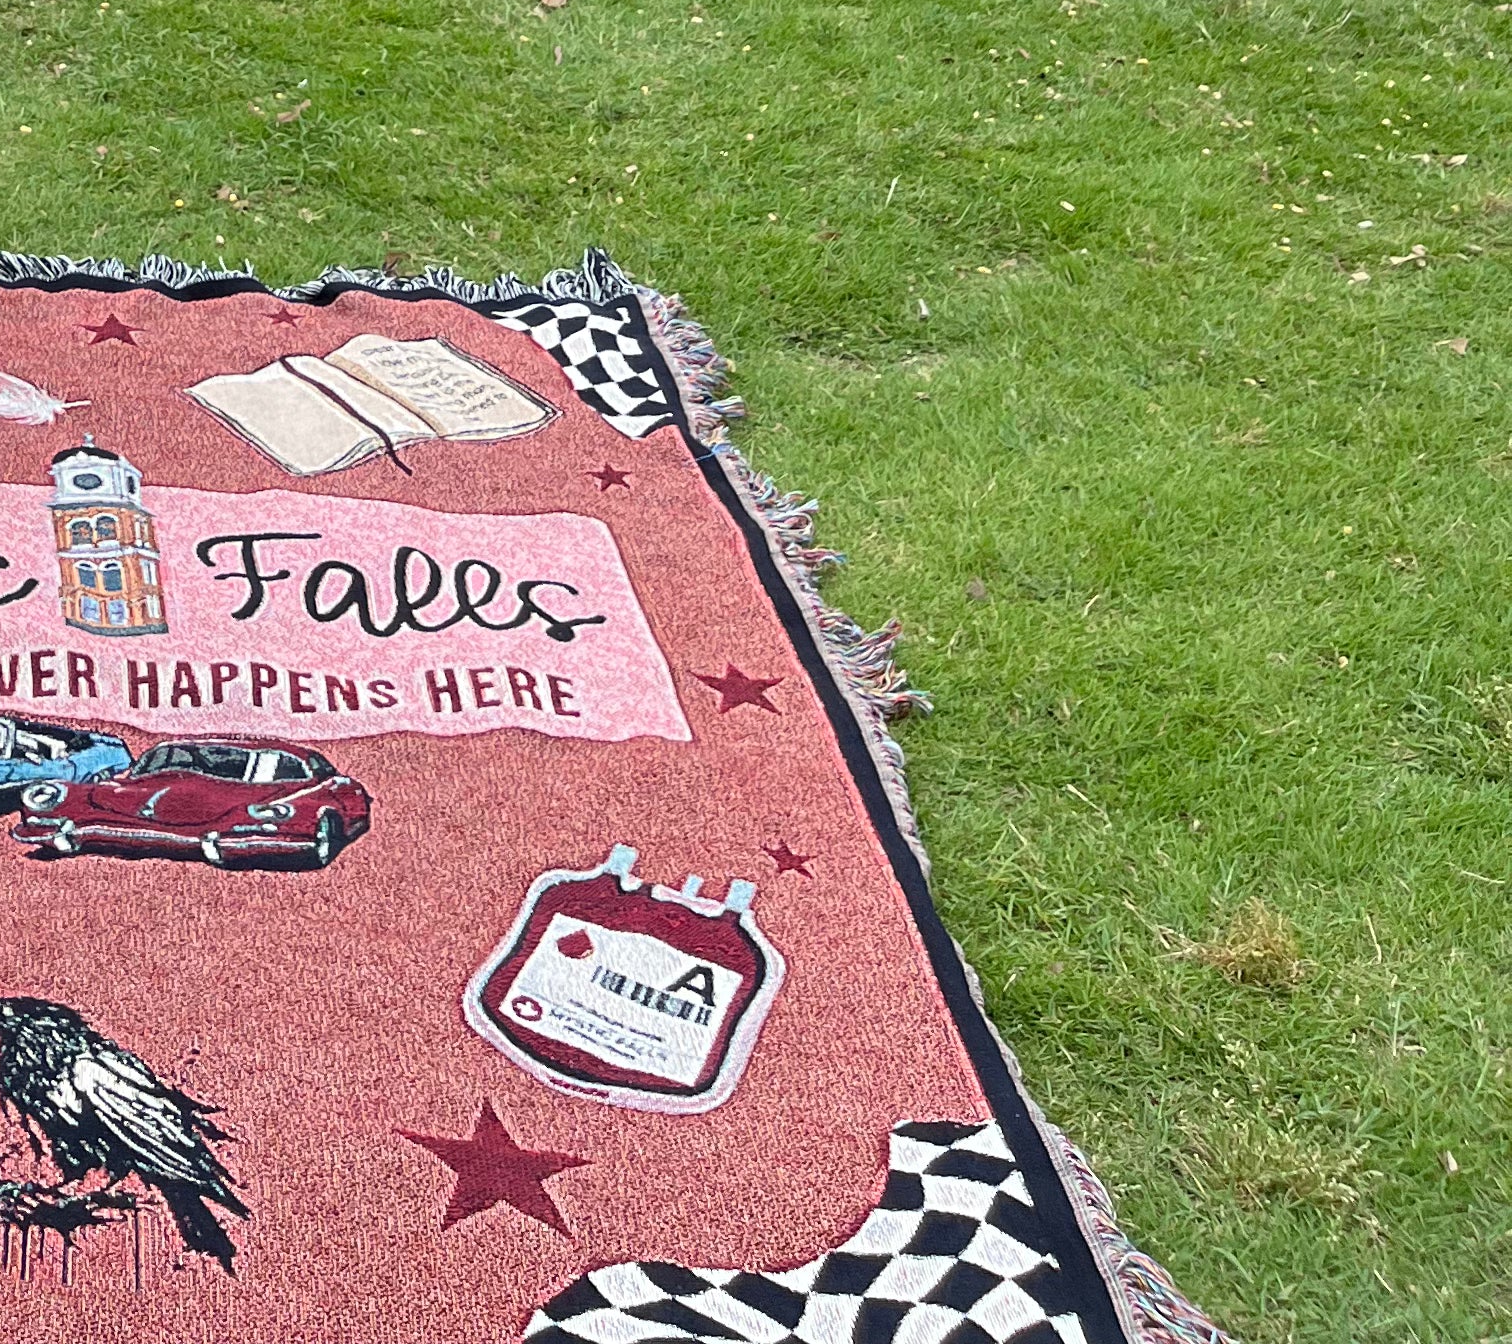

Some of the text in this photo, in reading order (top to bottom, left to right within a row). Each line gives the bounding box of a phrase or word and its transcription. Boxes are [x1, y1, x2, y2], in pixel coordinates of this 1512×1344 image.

[196, 531, 608, 643] Falls
[127, 658, 399, 715] HAPPENS
[424, 665, 581, 719] HERE
[664, 963, 717, 1009] A
